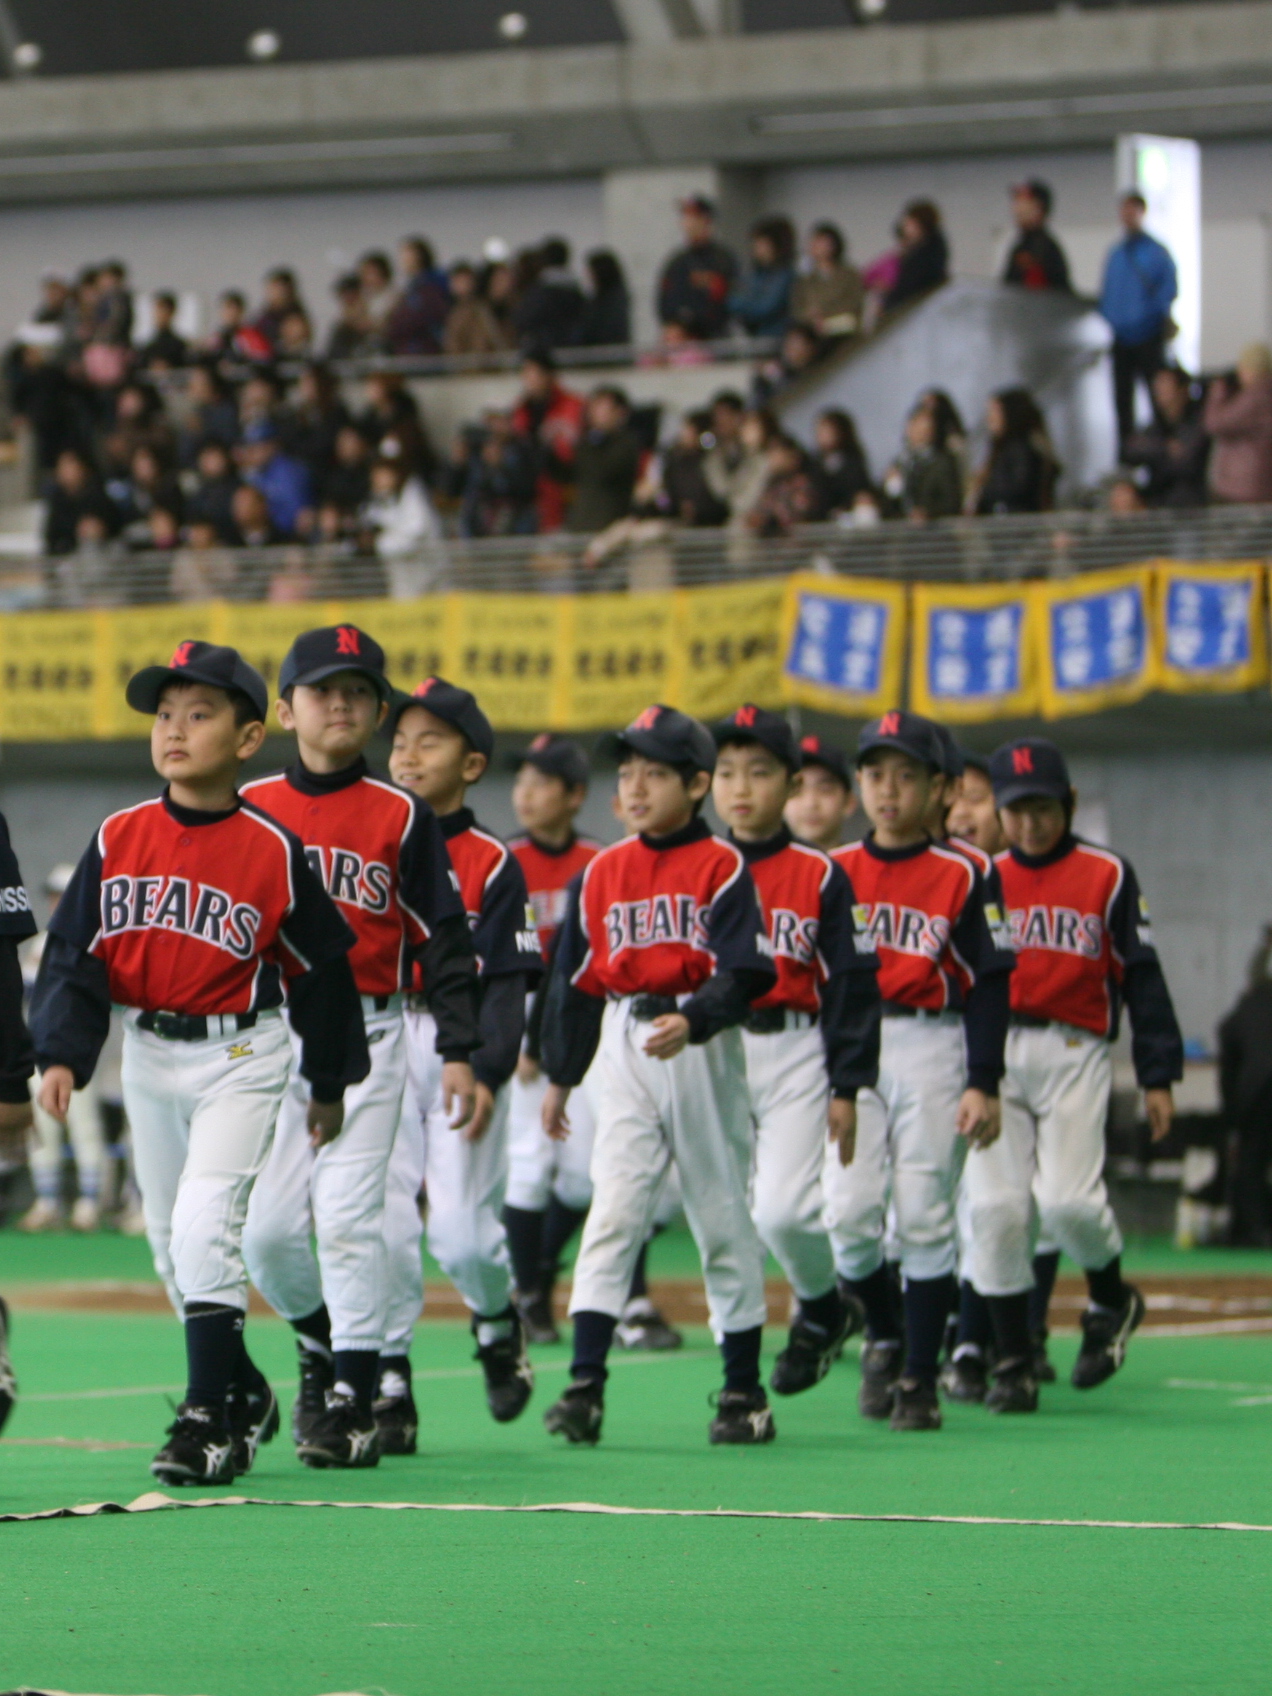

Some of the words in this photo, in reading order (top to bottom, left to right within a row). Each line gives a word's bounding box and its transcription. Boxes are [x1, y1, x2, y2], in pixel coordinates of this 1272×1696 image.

[336, 626, 360, 655] N
[735, 706, 757, 728] N
[878, 711, 901, 736] N
[1012, 747, 1033, 775] N
[100, 874, 262, 961] BEARS
